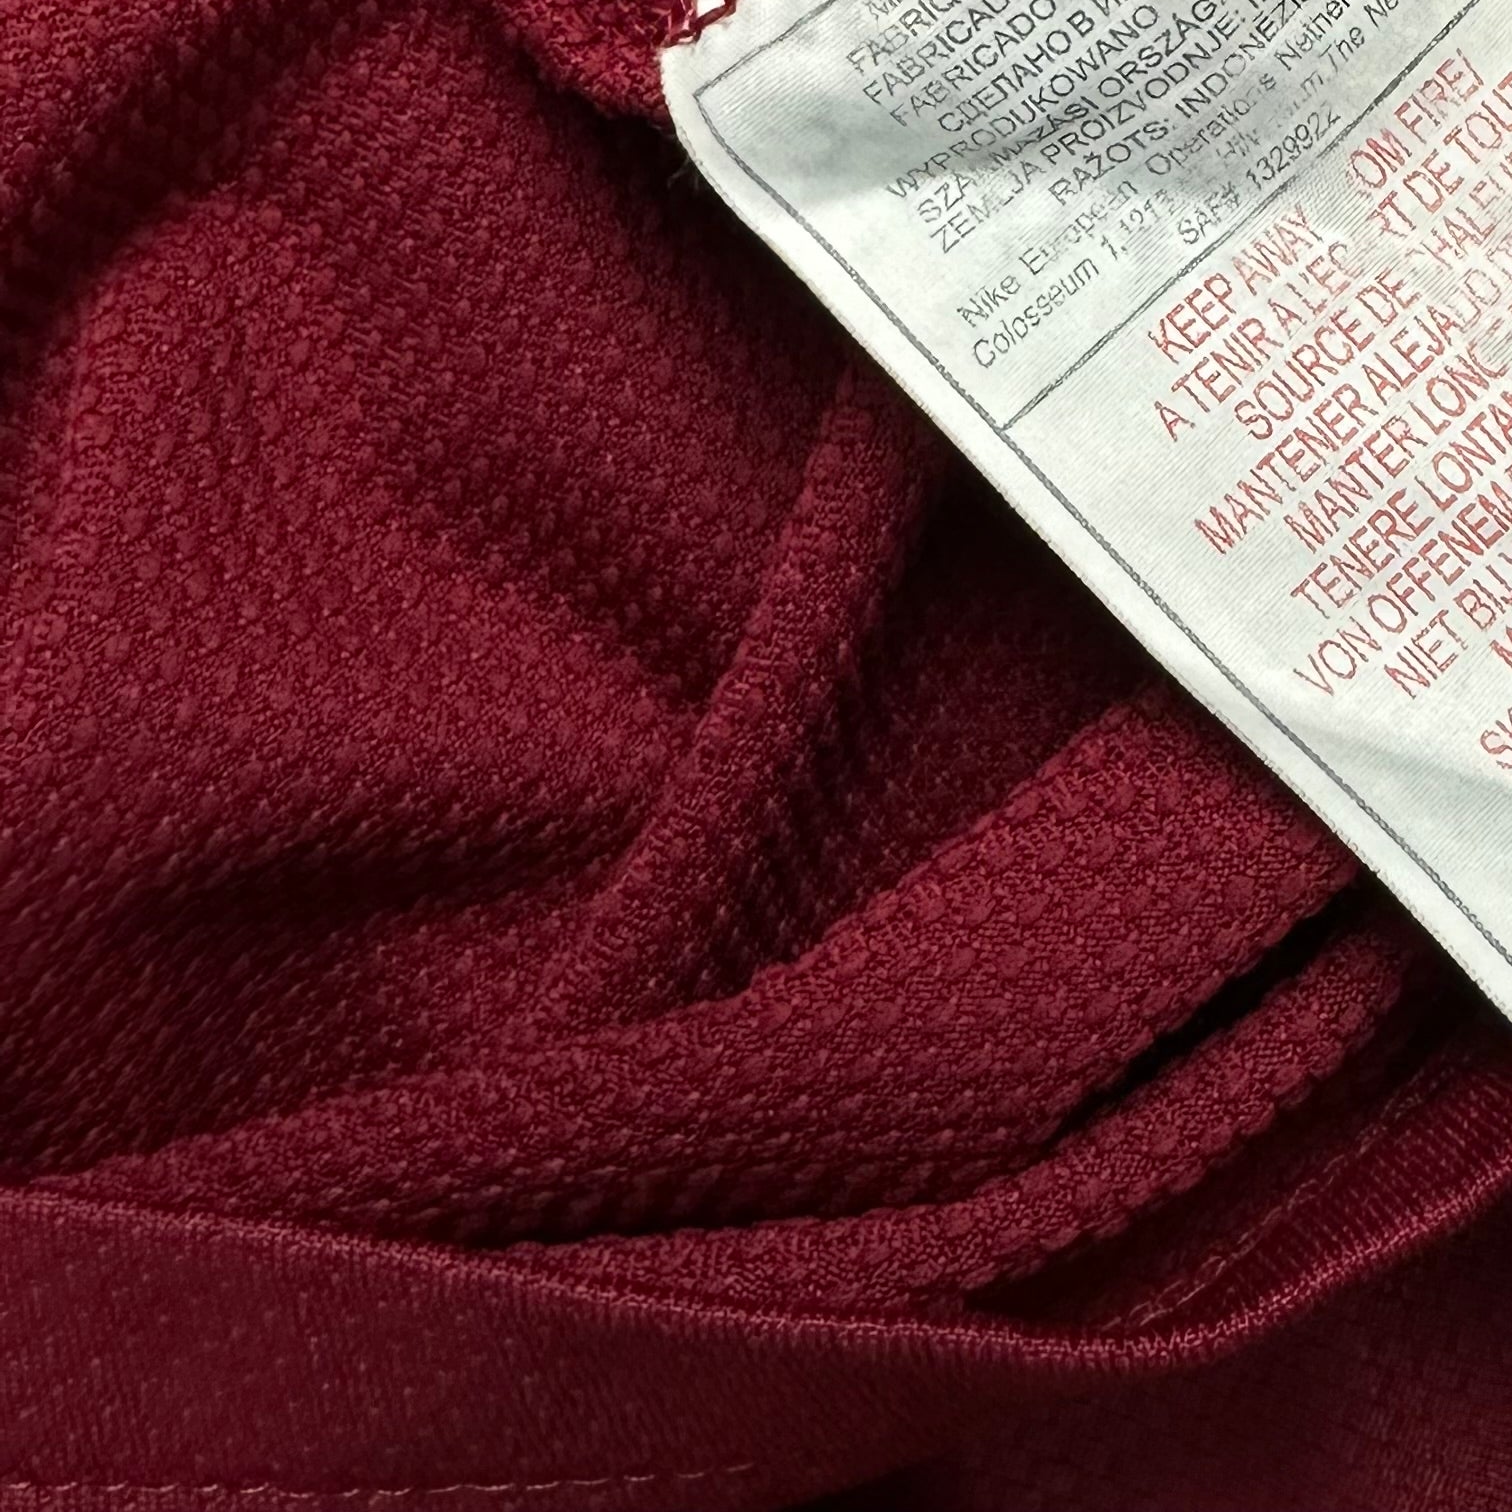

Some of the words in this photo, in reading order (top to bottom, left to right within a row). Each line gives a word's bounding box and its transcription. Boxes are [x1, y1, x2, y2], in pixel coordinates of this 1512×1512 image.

[1067, 10, 1094, 37] В
[886, 5, 1159, 198] WYPRODUKOWANO
[1040, 12, 1246, 165] PROIZVODNJE:
[1048, 118, 1169, 206] RAŽOTS:
[1246, 107, 1341, 190] 1329922
[1403, 149, 1464, 213] DE
[1148, 273, 1238, 363] KEEP
[1232, 202, 1323, 296] AWAY
[1394, 48, 1484, 144] FIRE/
[956, 275, 1021, 328] Nike
[973, 258, 1099, 369] Colosseum
[1171, 318, 1283, 412] TENIR
[1234, 308, 1375, 440] SOURCE
[1355, 268, 1419, 327] DE
[1154, 401, 1195, 442] A
[1195, 384, 1378, 554] MANTENER
[1284, 416, 1427, 552] MANTER
[1291, 489, 1434, 618] TENERE
[1293, 616, 1382, 696] VON
[1384, 610, 1467, 699] NIET
